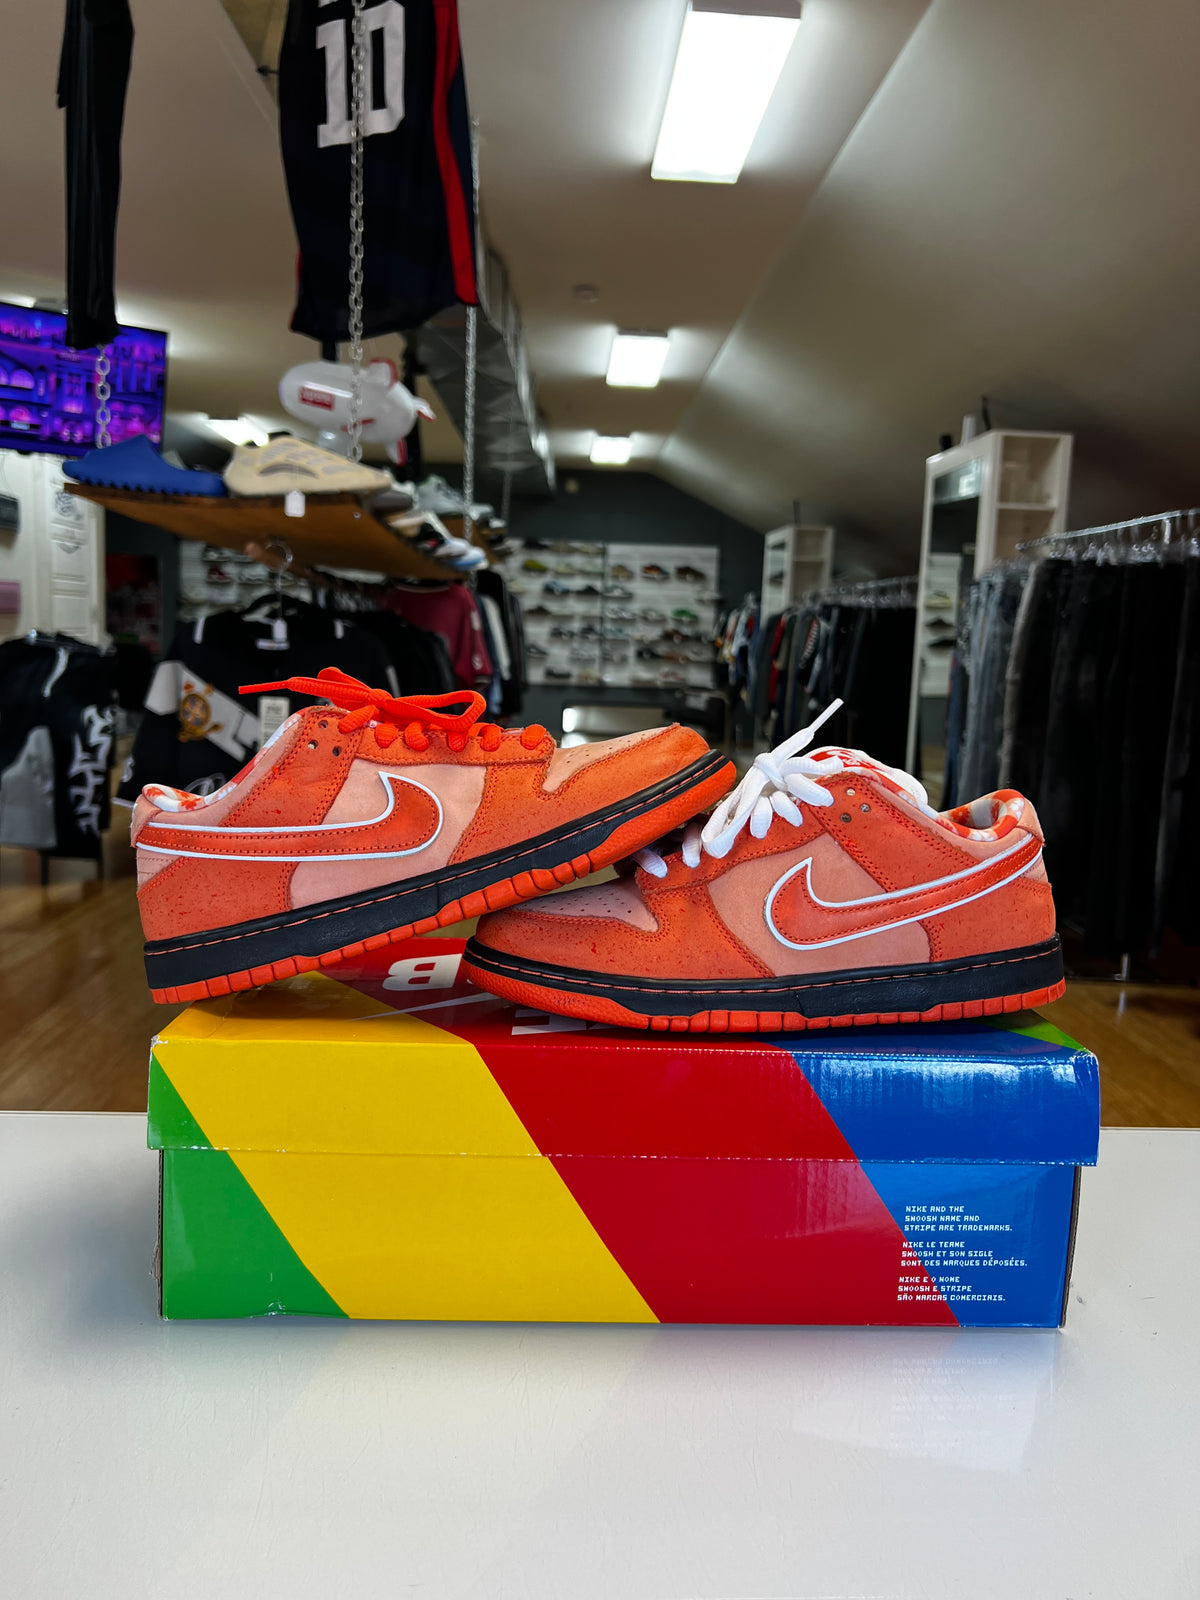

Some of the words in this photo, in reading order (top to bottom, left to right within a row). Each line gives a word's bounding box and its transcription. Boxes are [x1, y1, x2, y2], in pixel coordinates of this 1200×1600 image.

[316, 0, 406, 148] 10
[382, 953, 474, 992] B
[943, 1259, 980, 1267] MARQUES
[982, 1257, 1027, 1267] DÉPOSÉES.
[897, 1293, 913, 1301] SÃO
